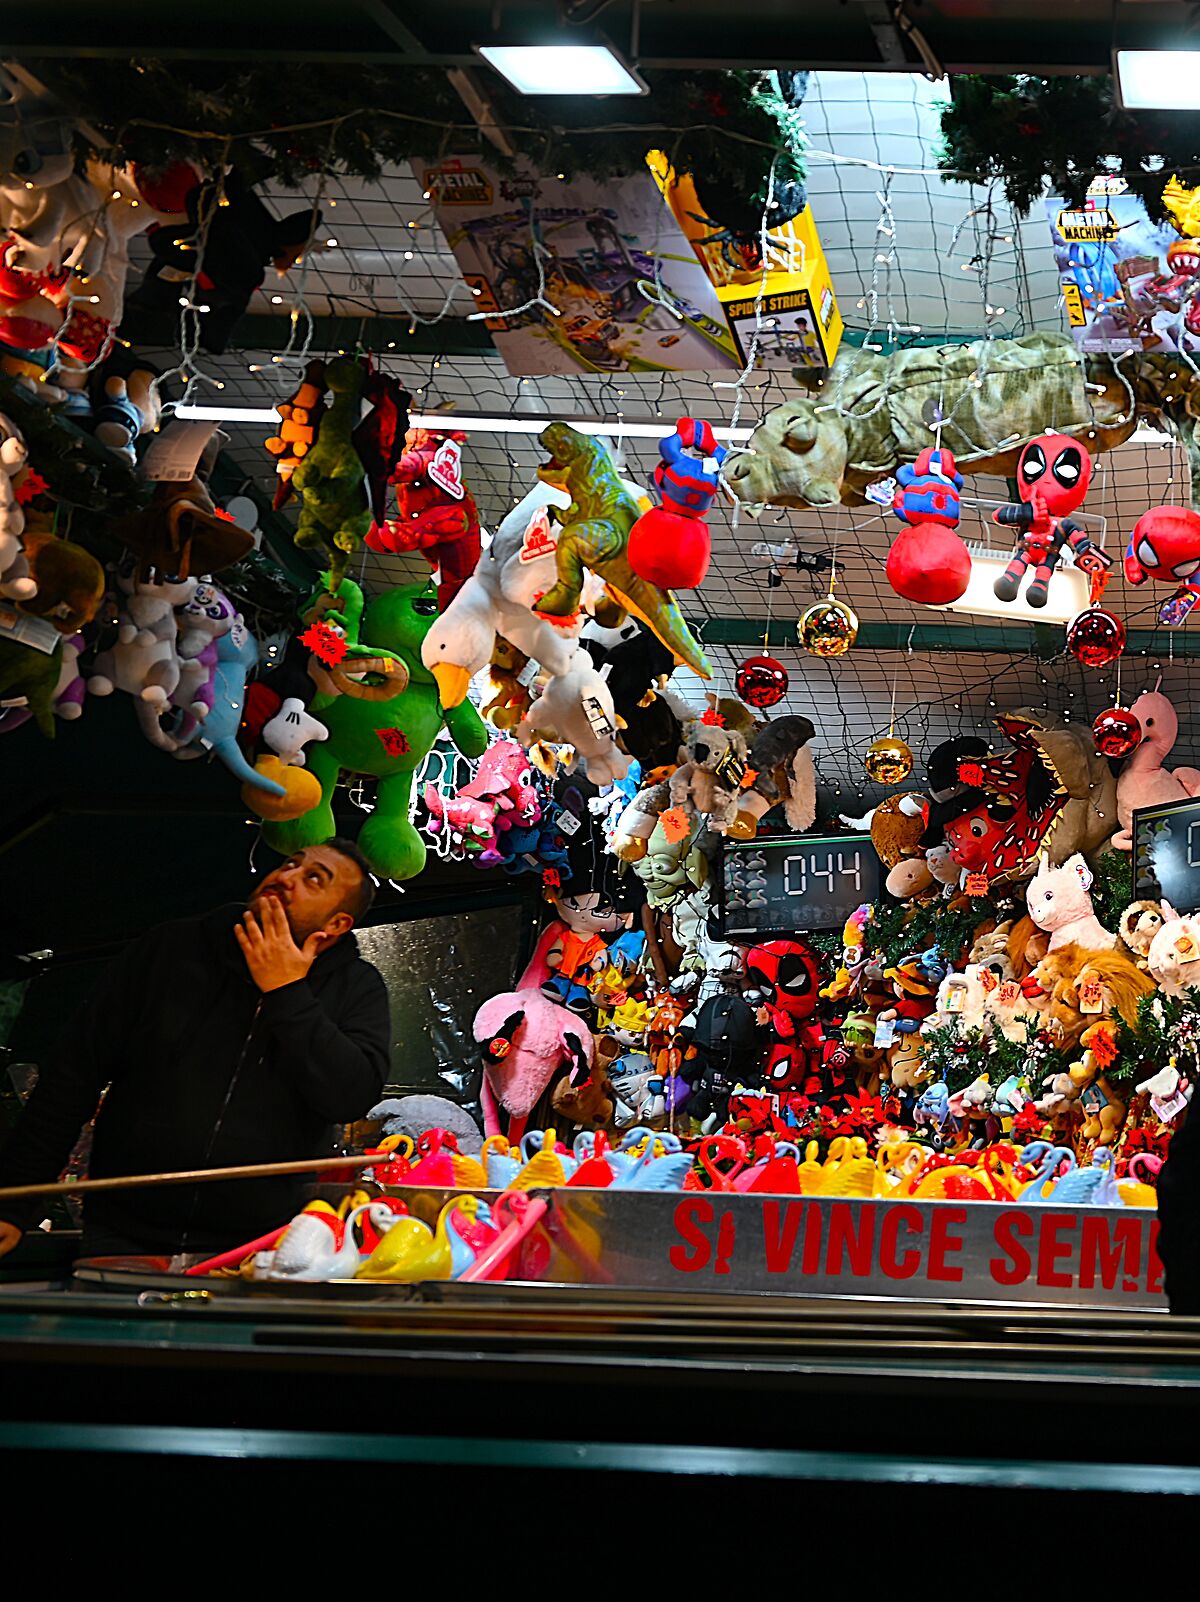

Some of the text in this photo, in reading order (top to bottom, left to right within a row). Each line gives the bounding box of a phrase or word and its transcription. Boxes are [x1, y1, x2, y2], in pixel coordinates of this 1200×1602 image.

[728, 299, 767, 318] SPIDR
[769, 292, 808, 311] STRIKE
[784, 851, 861, 896] 044
[762, 1200, 968, 1282] VINCE
